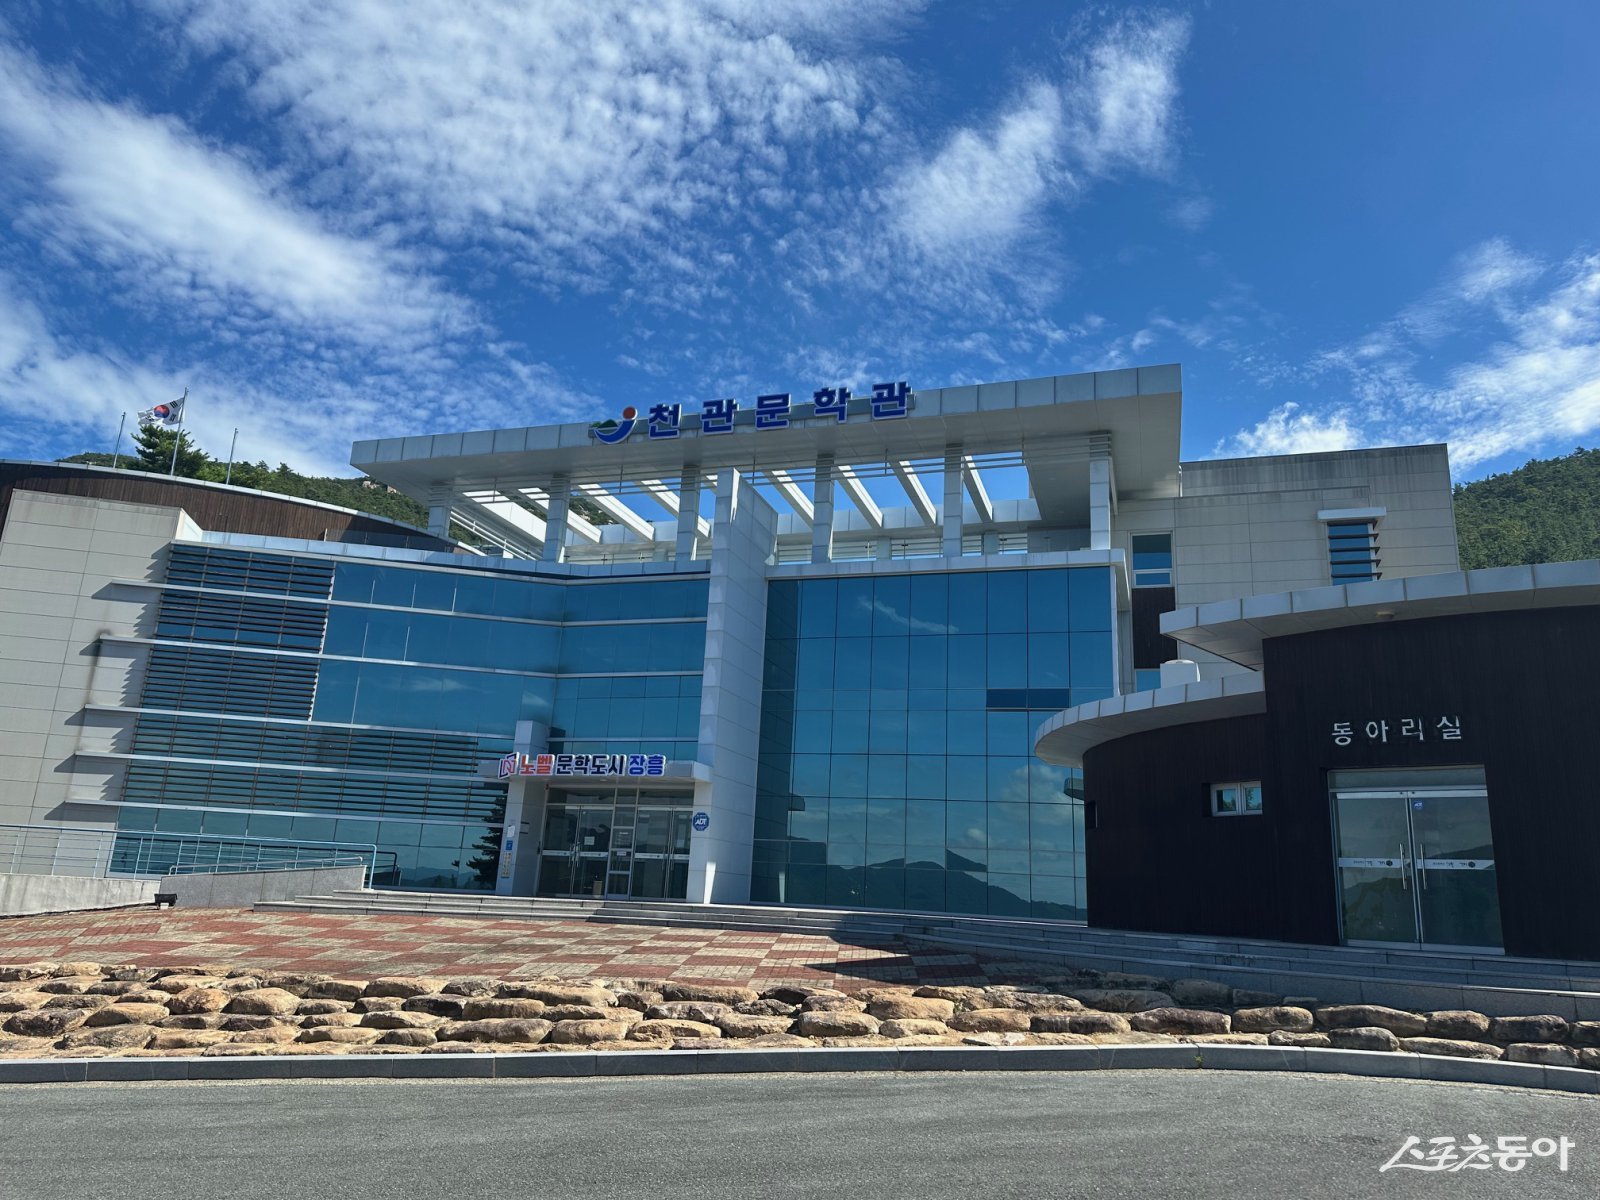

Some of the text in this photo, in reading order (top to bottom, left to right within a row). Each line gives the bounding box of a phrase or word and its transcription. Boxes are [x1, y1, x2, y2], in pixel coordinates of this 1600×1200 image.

[649, 382, 911, 439] 천관문학관
[1332, 715, 1462, 746] 동아리실
[519, 755, 664, 775] 노벨 문학도시 장흥
